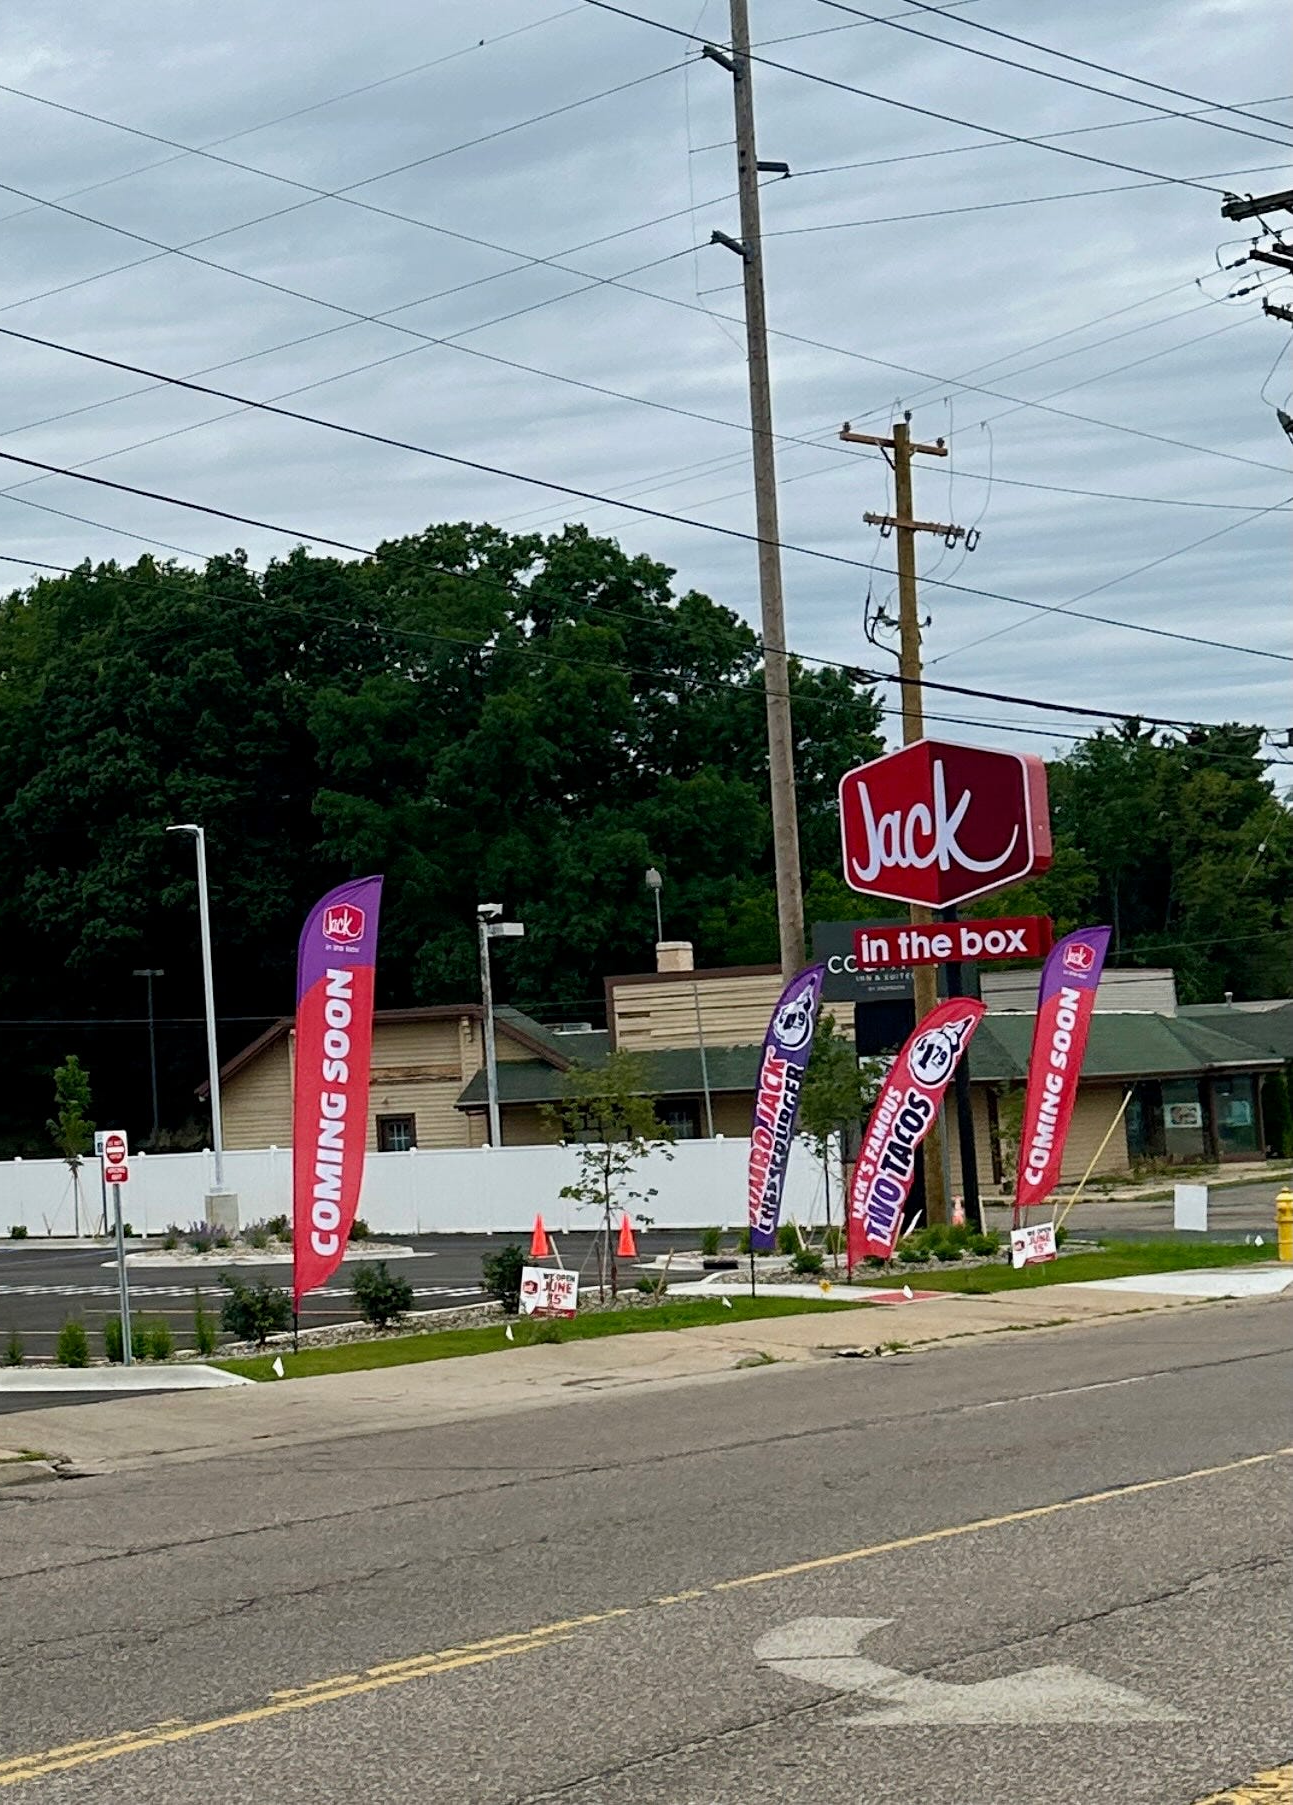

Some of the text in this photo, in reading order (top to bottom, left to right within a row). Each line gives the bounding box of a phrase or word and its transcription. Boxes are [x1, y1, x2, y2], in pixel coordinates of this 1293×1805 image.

[852, 759, 1019, 883] Jack
[326, 907, 362, 938] Jack
[860, 927, 1028, 963] in the box
[310, 968, 354, 1257] COMING SOON
[864, 1085, 903, 1164] FAMOUS
[1025, 1073, 1064, 1186] COMING
[1050, 987, 1081, 1070] SOON
[748, 1055, 787, 1228] JUMBO JACK
[863, 1087, 935, 1247] TWO TACOS
[542, 1282, 572, 1293] JUNE
[1028, 1232, 1051, 1245] JUNE
